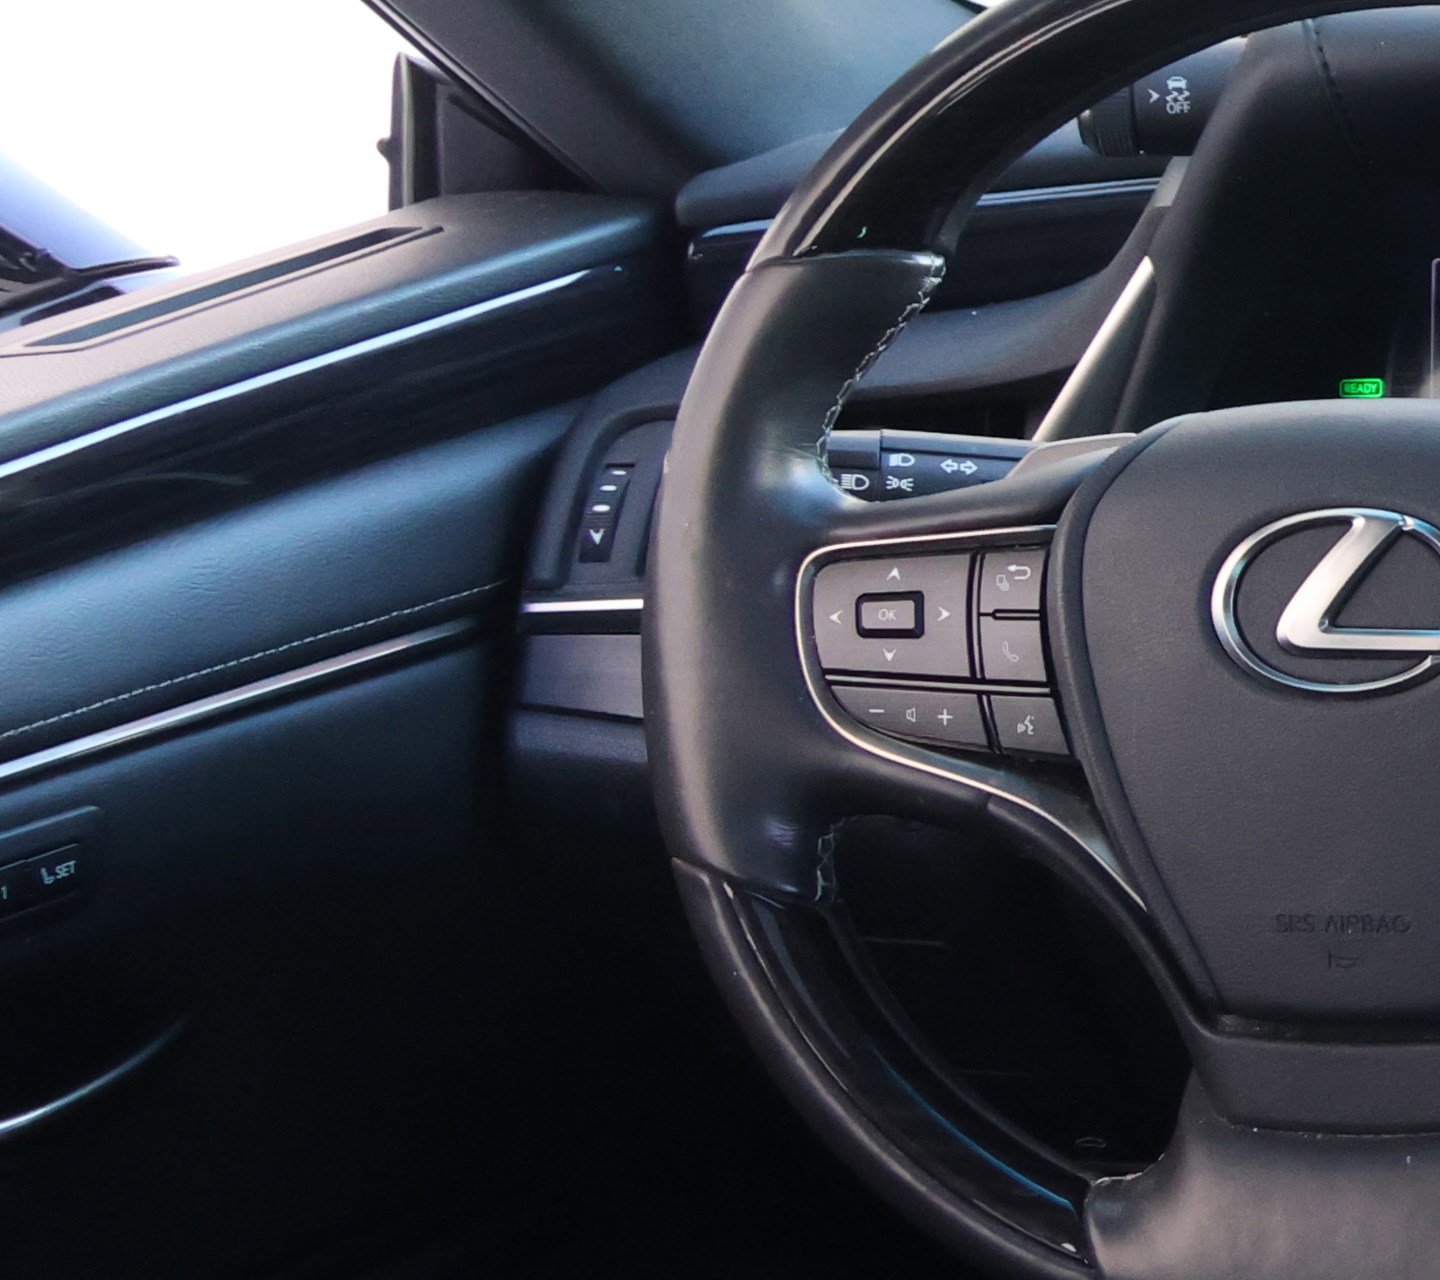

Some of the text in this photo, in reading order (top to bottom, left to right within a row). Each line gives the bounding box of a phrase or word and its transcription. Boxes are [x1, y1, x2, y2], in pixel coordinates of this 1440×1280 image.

[1166, 101, 1191, 114] OFF
[878, 608, 897, 622] OK
[55, 860, 77, 880] SET
